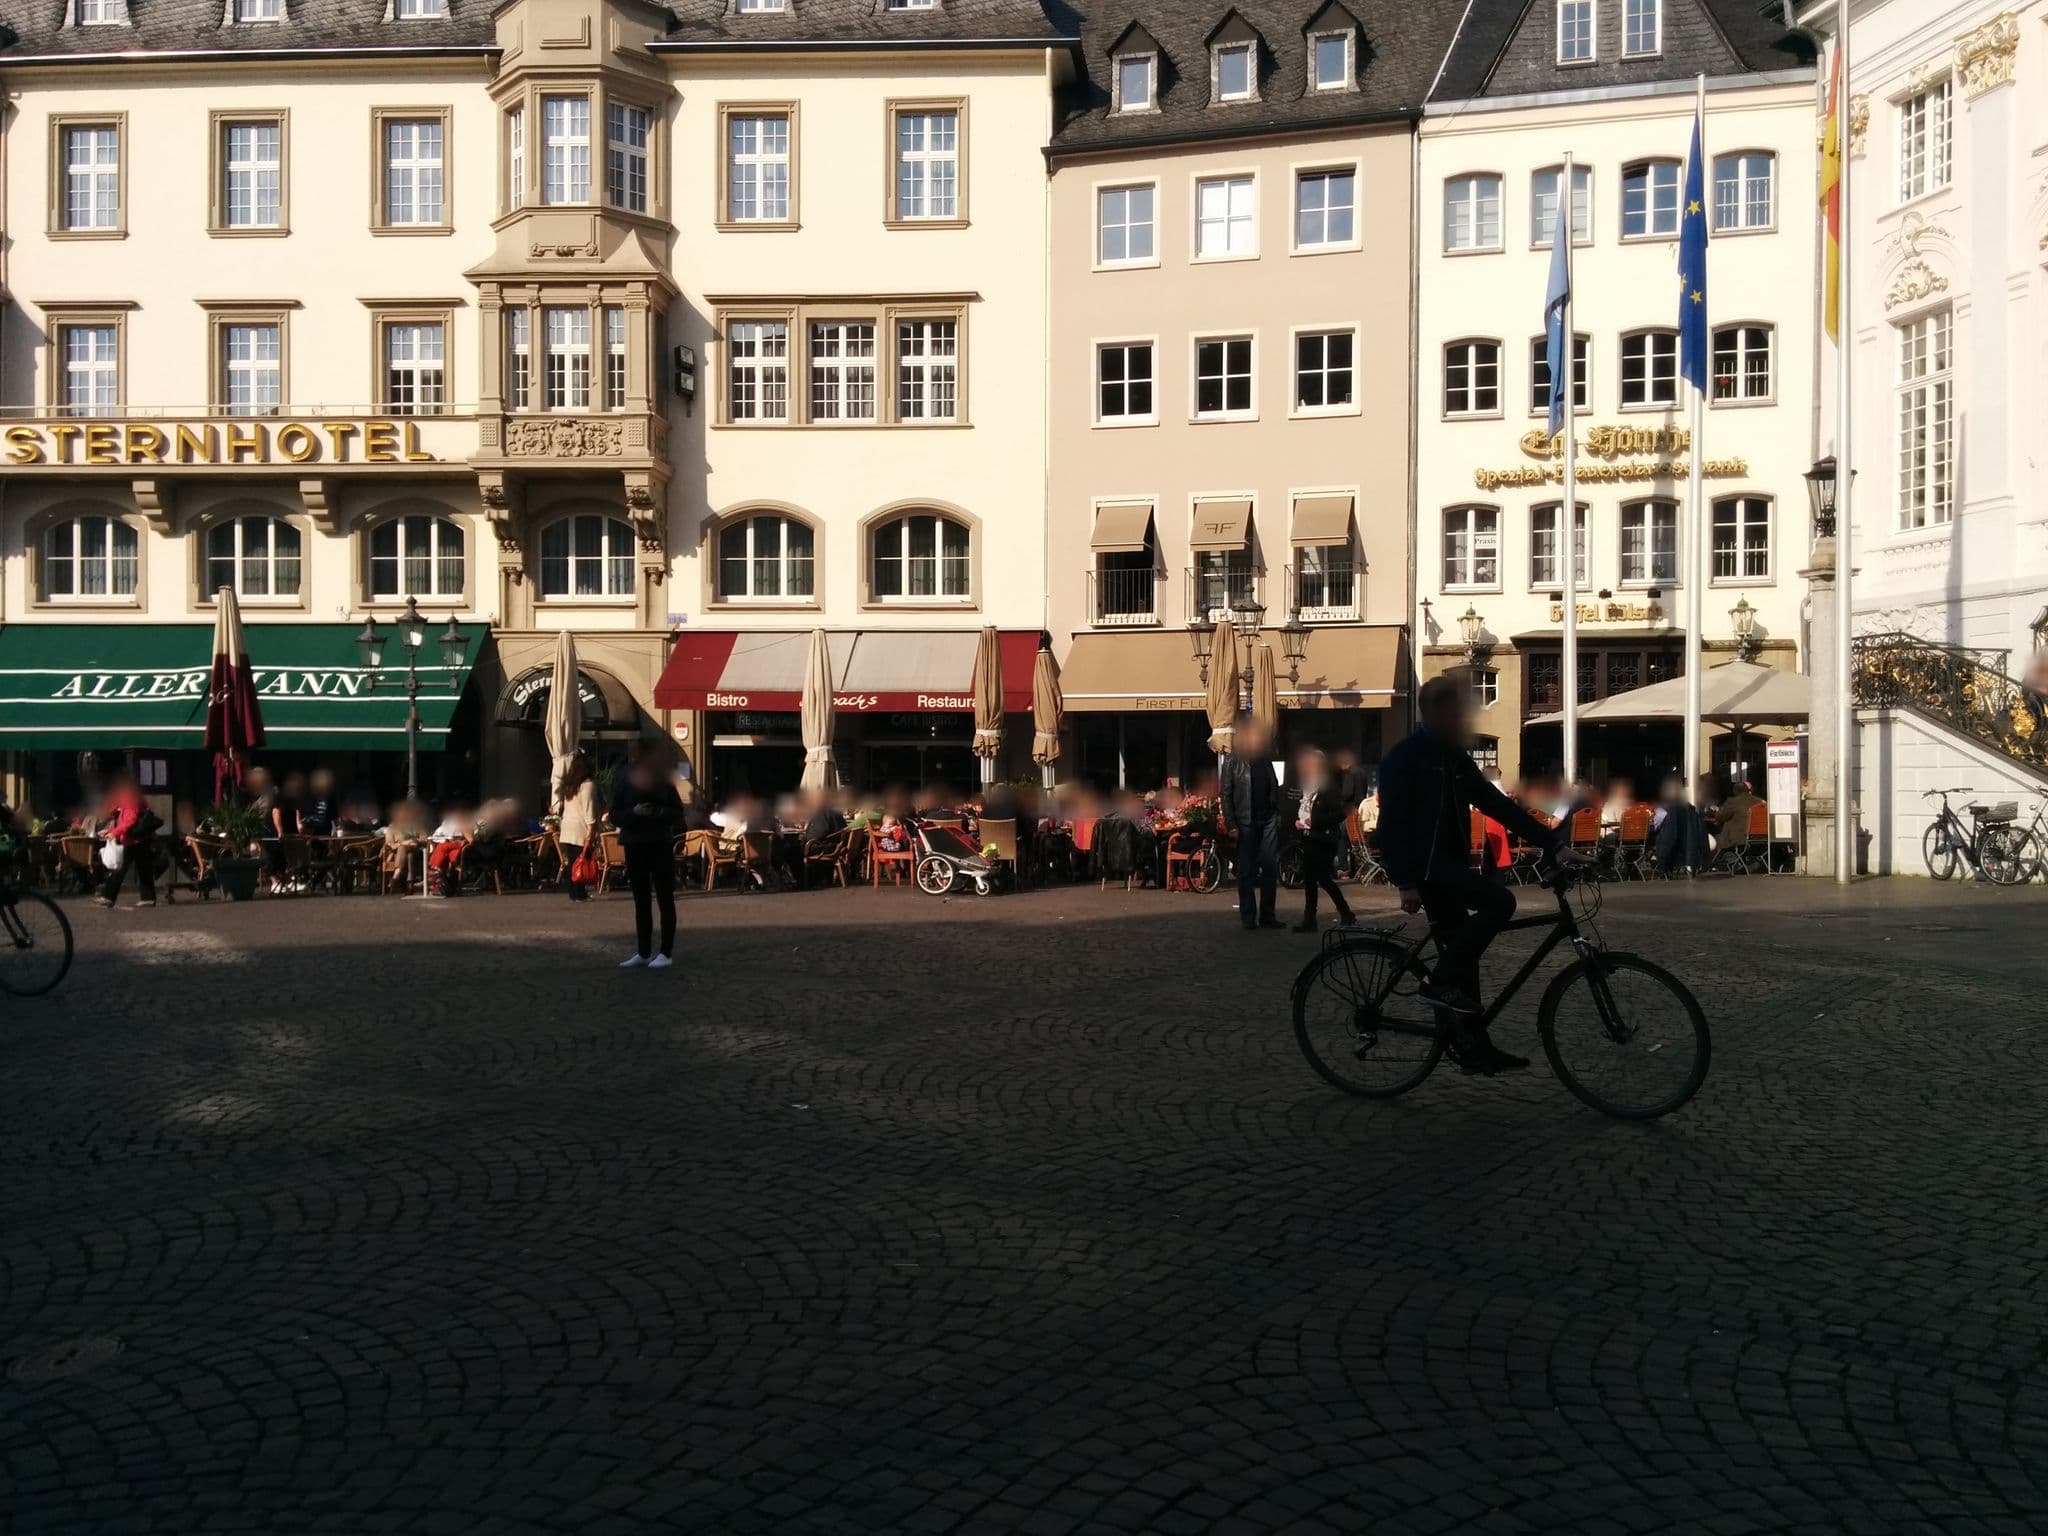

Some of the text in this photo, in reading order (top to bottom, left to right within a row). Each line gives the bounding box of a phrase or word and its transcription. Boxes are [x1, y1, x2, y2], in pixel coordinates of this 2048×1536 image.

[5, 421, 434, 464] STERNHOTEL
[513, 676, 596, 706] Sternel
[706, 693, 748, 707] Bistro
[917, 694, 977, 708] Restaura
[1180, 698, 1208, 709] FLU
